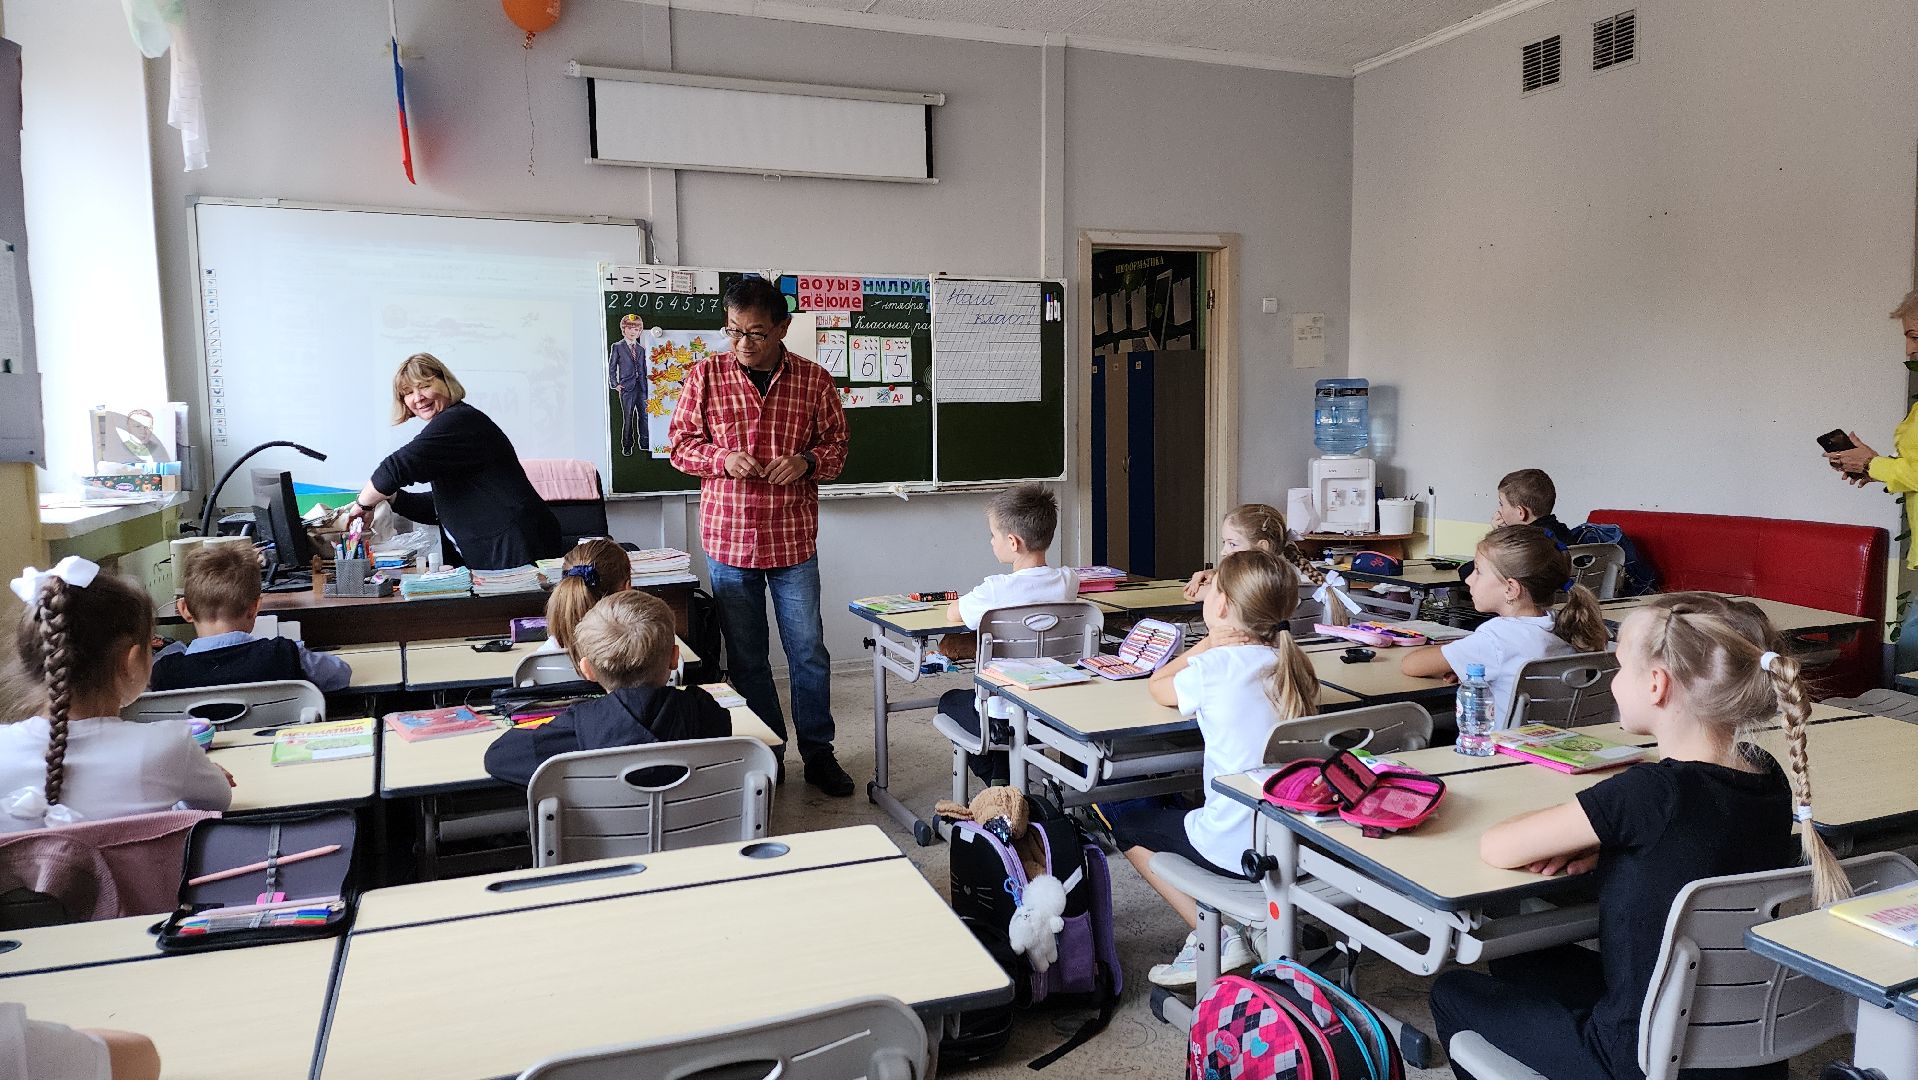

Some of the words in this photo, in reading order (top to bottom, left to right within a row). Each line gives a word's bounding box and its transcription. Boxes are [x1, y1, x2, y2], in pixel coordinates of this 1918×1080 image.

[871, 296, 925, 315] нтября
[946, 288, 996, 306] Наш
[854, 315, 911, 329] Классная
[910, 321, 931, 336] ра
